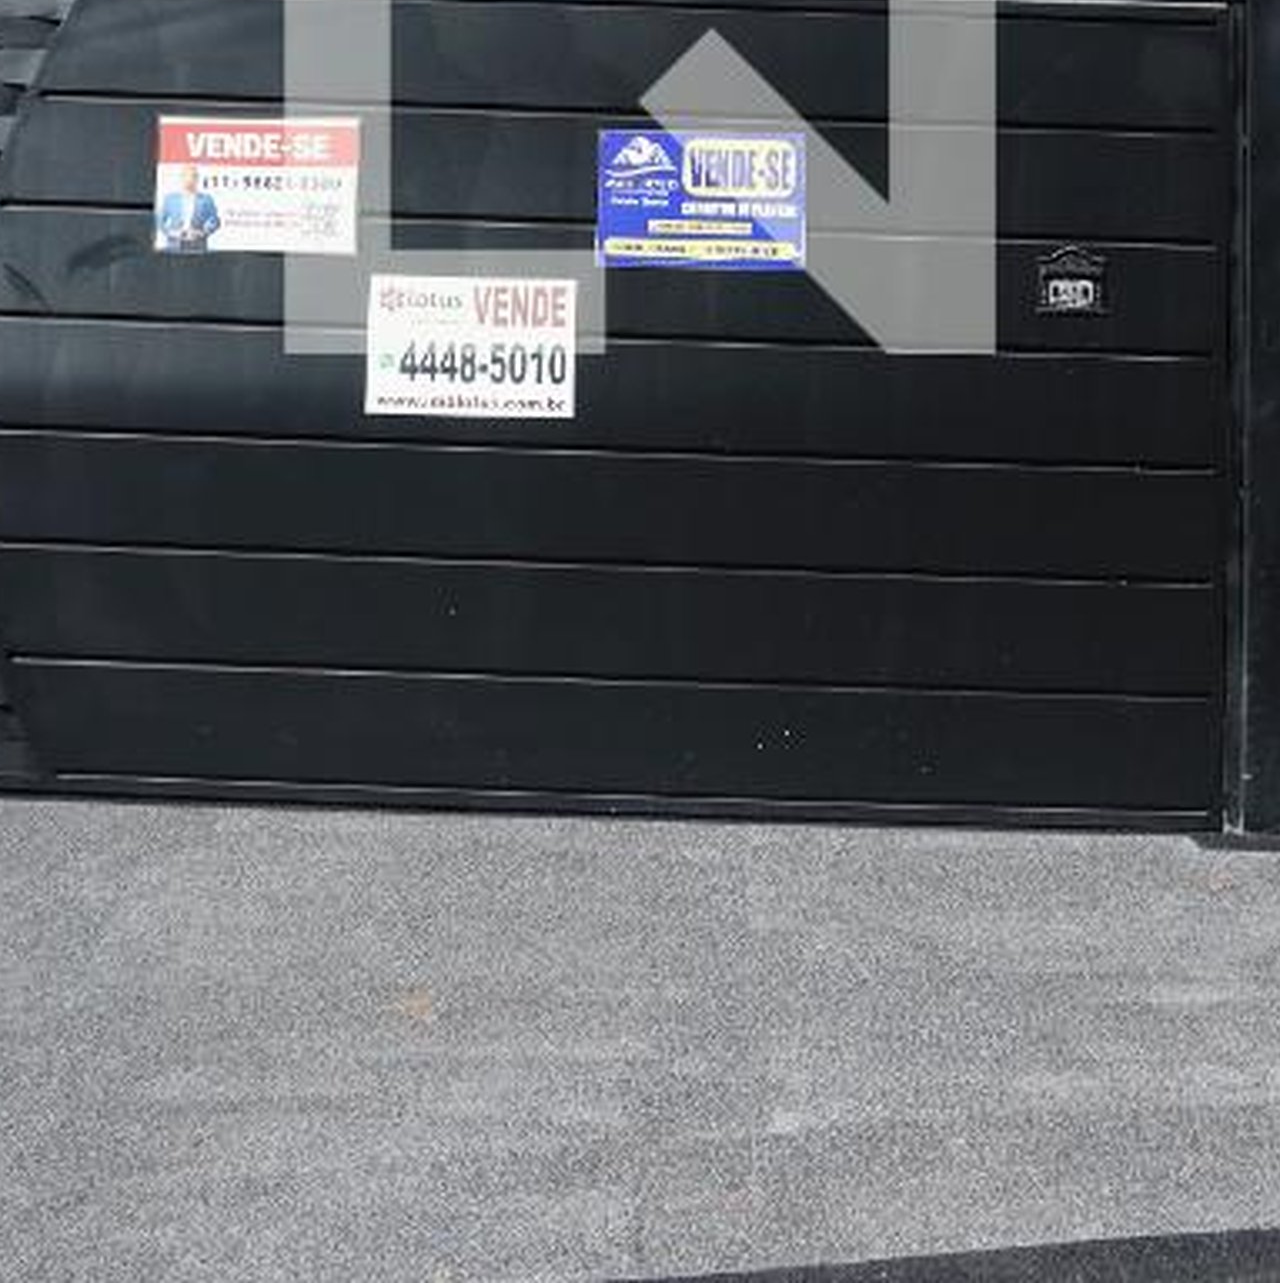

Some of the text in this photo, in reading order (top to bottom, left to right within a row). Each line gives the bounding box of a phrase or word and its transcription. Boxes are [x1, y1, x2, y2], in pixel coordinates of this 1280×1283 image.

[185, 130, 332, 160] VENDE-SE
[688, 144, 791, 192] VENDE-SE
[473, 285, 567, 328] VENDE
[399, 339, 568, 386] 4448-5010
